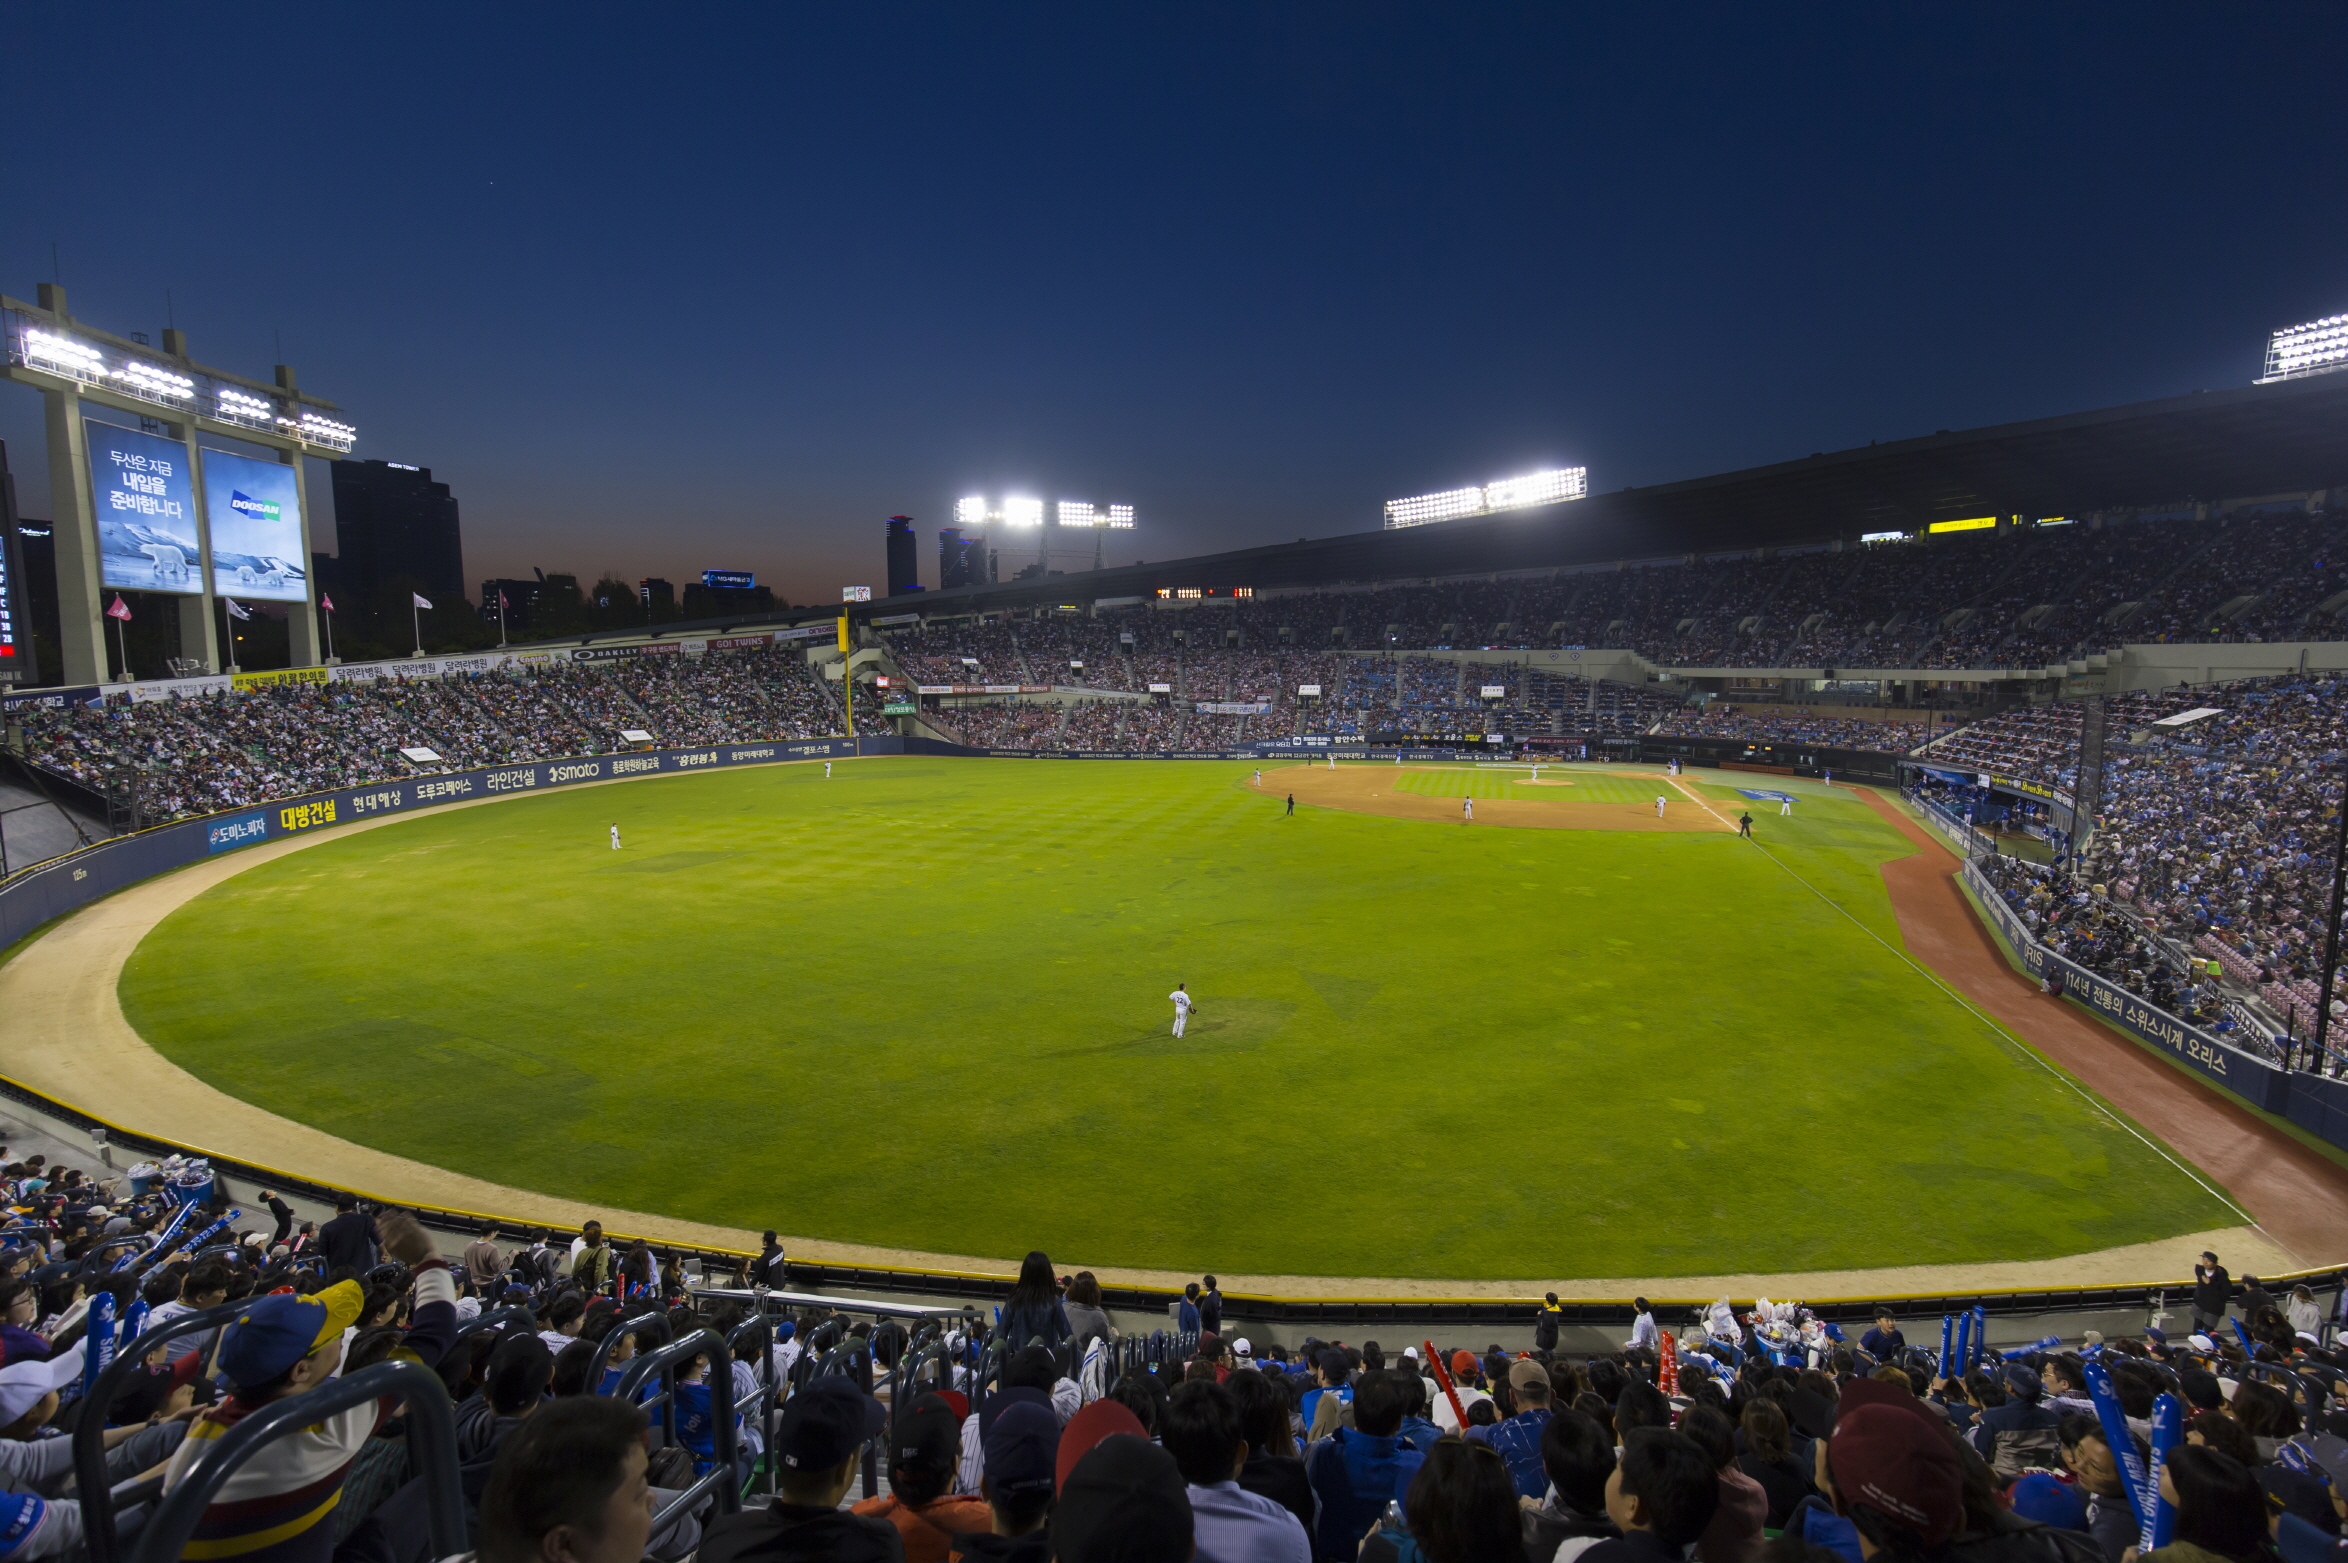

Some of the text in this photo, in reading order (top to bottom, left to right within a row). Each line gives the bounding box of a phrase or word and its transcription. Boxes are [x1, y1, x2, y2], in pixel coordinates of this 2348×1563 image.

[110, 450, 172, 476] 두산은 지금
[122, 472, 167, 496] 내일을
[110, 490, 182, 519] 준비합니다
[232, 499, 280, 514] DOOSAN
[0, 610, 10, 620] 1B
[1, 622, 11, 631] 3B
[3, 634, 12, 643] 2B
[734, 637, 763, 646] TWINS
[519, 656, 548, 664] Engino
[597, 648, 638, 657] OAKLEY
[392, 663, 436, 676] 달려라병원
[445, 658, 487, 671] 달려라병원
[336, 666, 382, 680] 달려라병원
[1334, 735, 1365, 743] 함안수박
[732, 749, 775, 760] 동양미래대학교
[803, 745, 830, 755] 겔포스엠
[558, 763, 599, 781] smato
[612, 757, 659, 774] 종로학원하늘교육
[487, 769, 535, 791] 라인건설
[417, 778, 472, 800] 도루코페이스
[353, 790, 401, 812] 현대해상
[280, 799, 336, 830] 대방건설
[219, 818, 265, 842] 도미노피자
[2024, 943, 2043, 966] ORIS
[2065, 970, 2227, 1076] 114년 전통의 스위스시계 오리스
[2146, 1446, 2162, 1522] SAMSUNG
